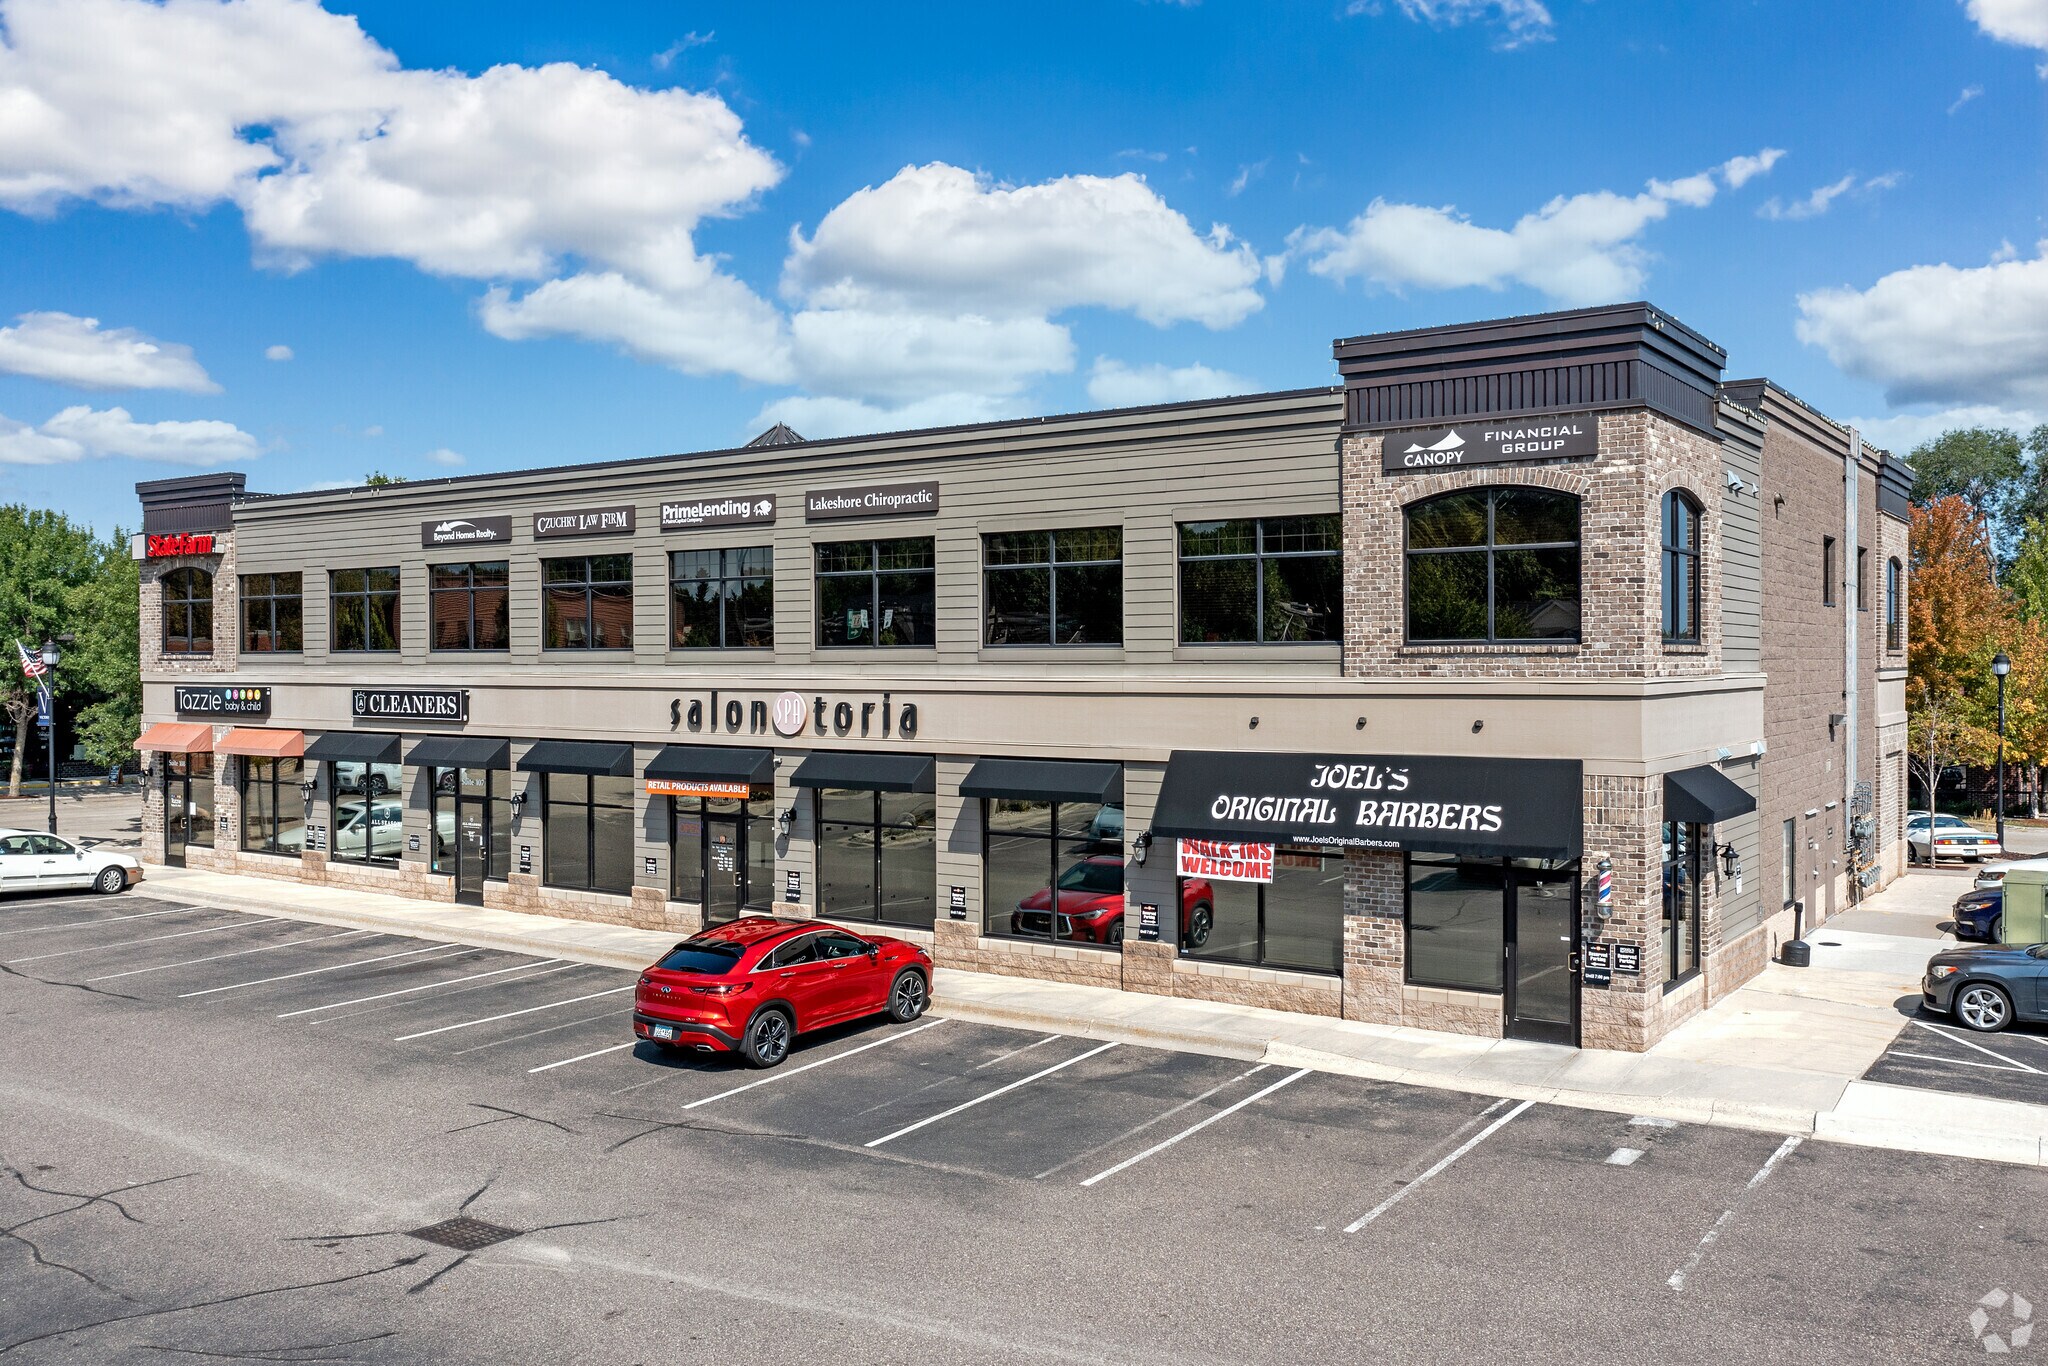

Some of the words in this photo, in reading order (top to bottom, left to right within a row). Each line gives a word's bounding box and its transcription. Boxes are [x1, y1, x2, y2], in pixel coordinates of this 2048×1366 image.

[1484, 425, 1583, 442] FINANCIAL
[1501, 439, 1565, 454] GROUP
[1404, 451, 1465, 467] CANOPY
[662, 500, 751, 518] PrimeLending
[810, 496, 862, 511] Lakeshore
[864, 489, 933, 509] Chiropractic
[537, 516, 577, 533] CZUCHRY
[579, 514, 599, 529] LAW
[601, 511, 628, 529] FIRM
[433, 531, 455, 543] Beyond
[455, 531, 476, 540] Homes
[476, 528, 496, 540] Realty
[177, 689, 222, 711] Tazzie
[225, 701, 240, 713] baby
[240, 701, 246, 711] &
[247, 701, 262, 711] child
[369, 694, 457, 715] CLEANERS
[670, 691, 767, 730] salon
[776, 698, 800, 725] SPA
[814, 692, 918, 733] toria
[648, 781, 671, 790] RETAIL
[671, 782, 709, 792] PRODUCTS
[709, 784, 747, 794] AVAILABLE
[1311, 764, 1409, 791] JOEL'S
[1211, 795, 1337, 824] ORIGINAL
[1355, 800, 1503, 832] BARBERS
[1181, 837, 1272, 861] WALK-INS
[1292, 836, 1400, 848] www.JoelsOriginalBarbers.com
[1181, 855, 1272, 879] WELCOME
